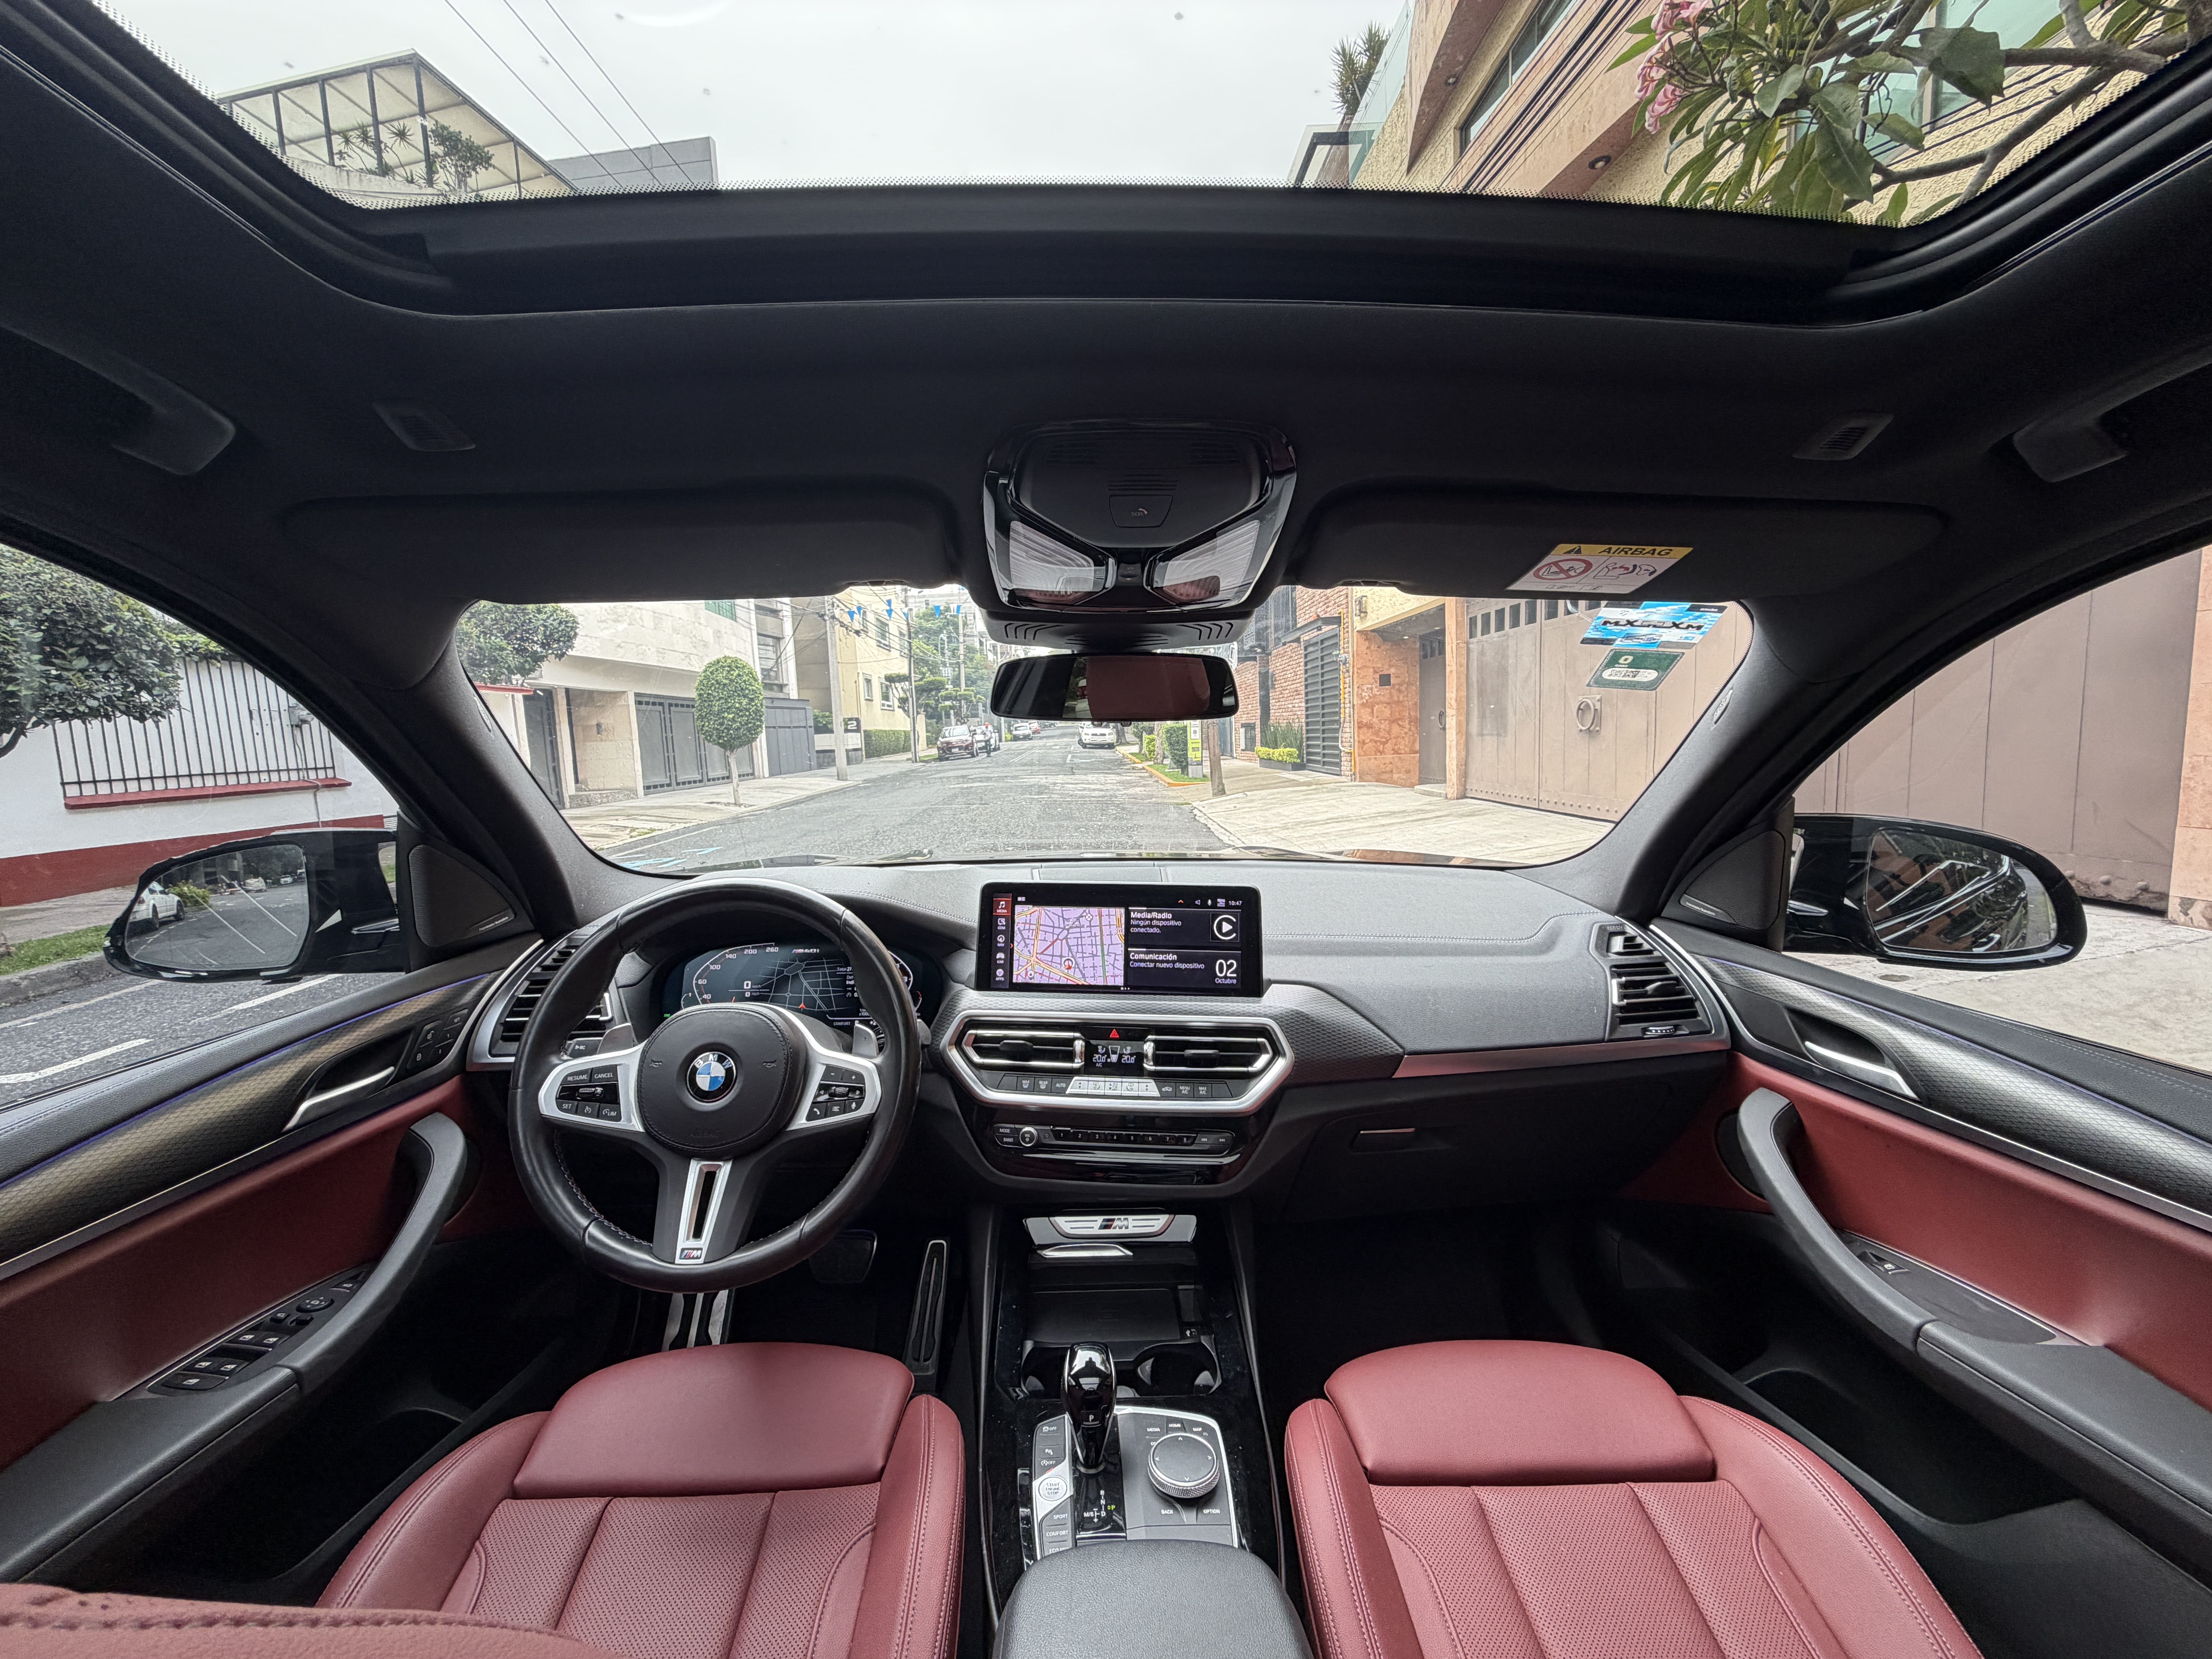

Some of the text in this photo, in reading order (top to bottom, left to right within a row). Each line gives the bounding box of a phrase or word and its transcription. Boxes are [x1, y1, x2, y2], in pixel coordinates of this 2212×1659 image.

[1598, 547, 1673, 556] AIRBAG
[1130, 952, 1177, 960] Comunicación
[1216, 960, 1237, 977] 02
[694, 1054, 732, 1069] BMW
